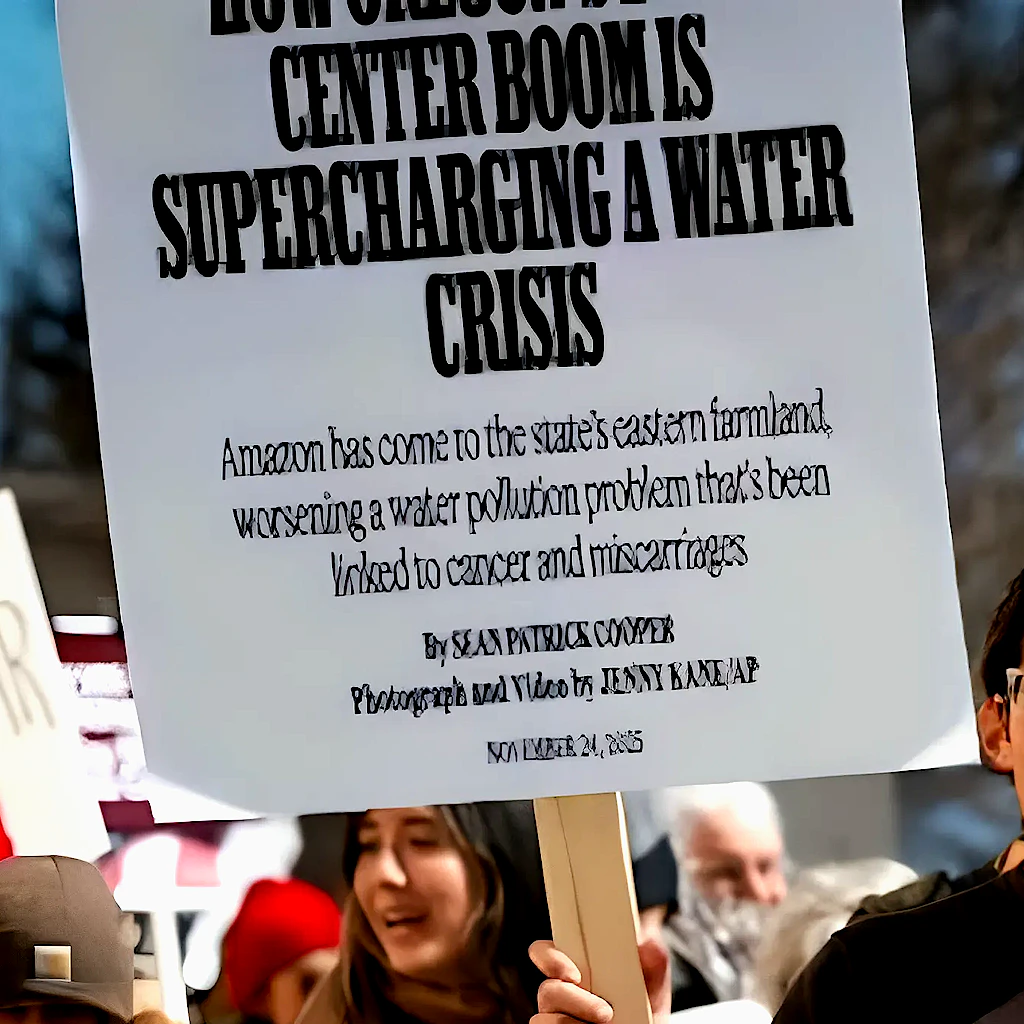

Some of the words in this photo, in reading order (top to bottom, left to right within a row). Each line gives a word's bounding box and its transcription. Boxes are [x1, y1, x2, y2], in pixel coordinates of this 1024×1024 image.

[270, 33, 487, 151] CENTER
[487, 18, 654, 134] BOOM
[655, 13, 714, 121] IS
[152, 140, 612, 280] SUPERCHARGING
[623, 139, 660, 242] A
[660, 124, 854, 240] WATER
[425, 262, 605, 378] CRISIS
[222, 437, 326, 480] Amazon
[328, 425, 374, 469] has
[378, 430, 448, 466] come
[453, 428, 480, 461] to
[484, 414, 527, 458] the
[531, 409, 608, 455] state's
[613, 408, 707, 449] eastern
[710, 388, 833, 441] farmland,
[233, 491, 367, 542] worsening
[370, 499, 386, 531] a
[388, 486, 460, 527] water
[466, 475, 581, 535] pollution
[584, 464, 691, 524] problem
[695, 459, 763, 504] that's
[765, 456, 831, 500] been
[331, 547, 410, 597] linked
[414, 553, 440, 589] to
[446, 550, 530, 587] cancer
[538, 533, 585, 581] and
[589, 527, 748, 578] miscarriages
[452, 628, 503, 659] SEAN
[505, 621, 592, 655] PATRICK
[594, 614, 675, 648] COOPER
[601, 662, 663, 694] JENNY
